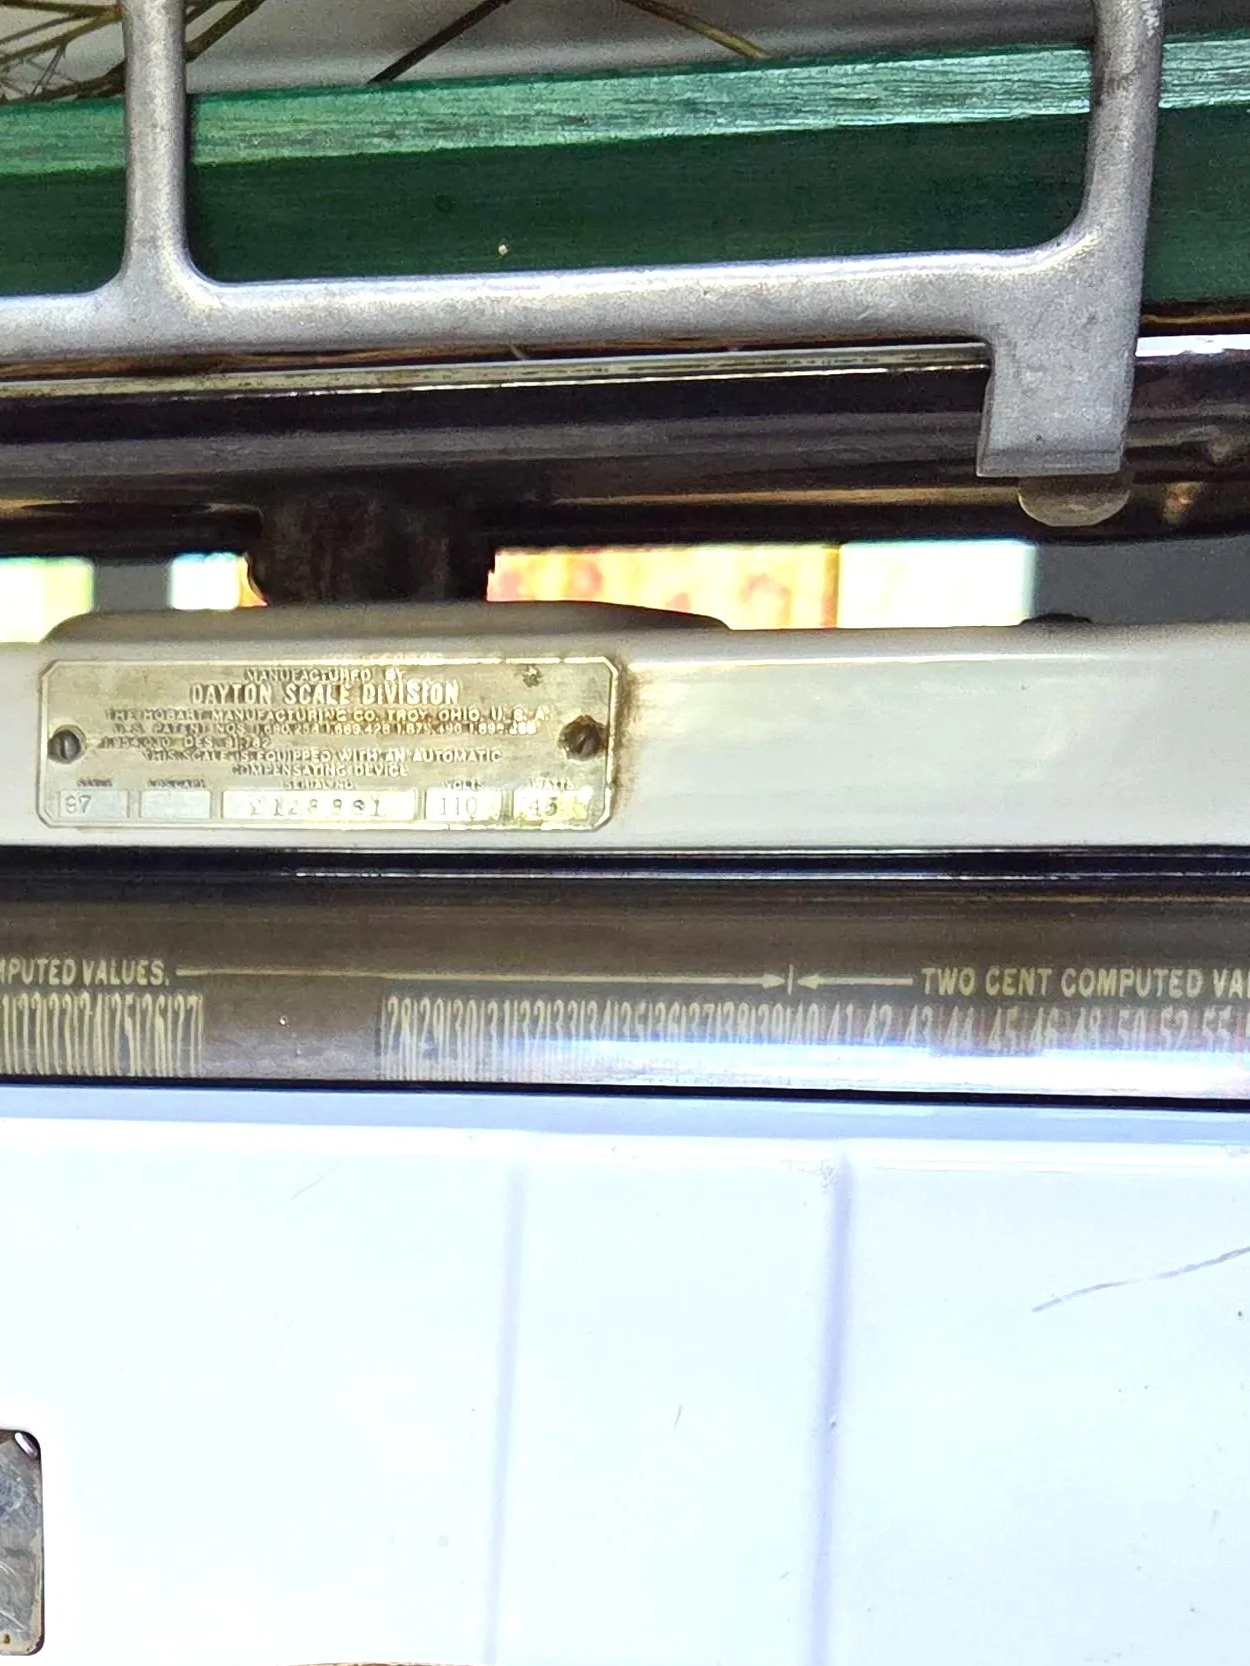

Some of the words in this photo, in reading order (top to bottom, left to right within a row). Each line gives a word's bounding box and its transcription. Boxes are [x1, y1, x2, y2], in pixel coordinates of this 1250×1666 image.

[385, 667, 405, 681] BY
[190, 683, 272, 705] DAYTON
[284, 683, 351, 705] SCALE
[362, 681, 460, 705] DIVISION
[105, 708, 136, 721] THE
[143, 708, 206, 721] HOBART
[212, 708, 348, 722] MANUFACTURING
[143, 750, 178, 762] THIS
[182, 750, 228, 762] SCALE
[234, 750, 251, 762] IS
[257, 750, 332, 763] EQUIPPED
[337, 750, 379, 763] WITH
[384, 750, 407, 762] AN
[413, 749, 502, 763] AUTOMATIC
[232, 763, 349, 777] COMPENSATING
[354, 763, 410, 777] DEVICE
[444, 779, 484, 790] VOLTS
[529, 778, 576, 790] WATTS
[82, 959, 170, 986] VALUES.
[922, 967, 976, 997] TWO
[985, 967, 1052, 997] CENT
[1060, 967, 1203, 997] COMPUTED
